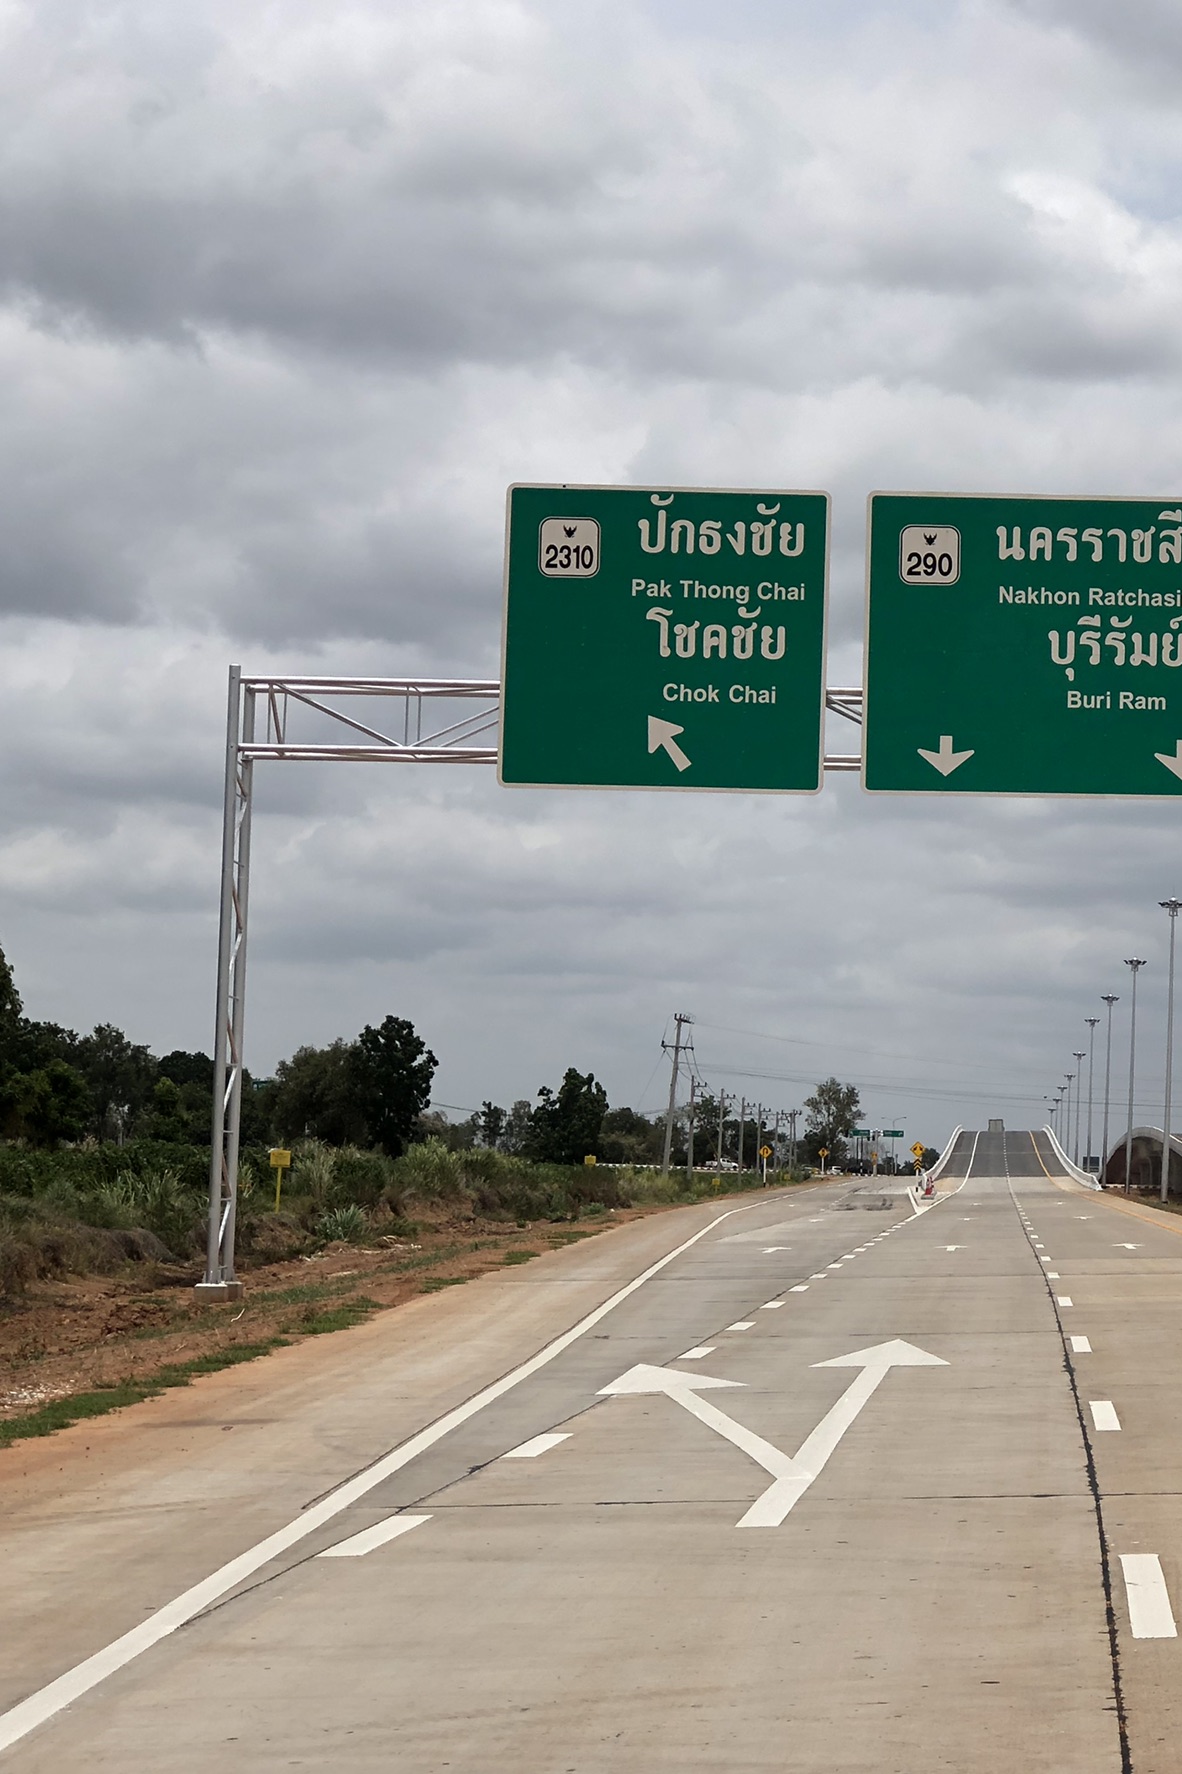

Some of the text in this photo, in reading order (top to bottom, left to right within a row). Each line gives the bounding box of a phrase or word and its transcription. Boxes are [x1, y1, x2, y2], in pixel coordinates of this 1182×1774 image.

[638, 493, 806, 556] ปักธงชัย
[544, 545, 593, 570] 2310
[906, 552, 953, 577] 290
[631, 579, 806, 604] Pak Thong Chai
[999, 585, 1080, 605] Nakhon
[646, 606, 786, 660] โชคชัย
[662, 683, 776, 704] Chok Chai
[1066, 690, 1166, 710] Buri Ram
